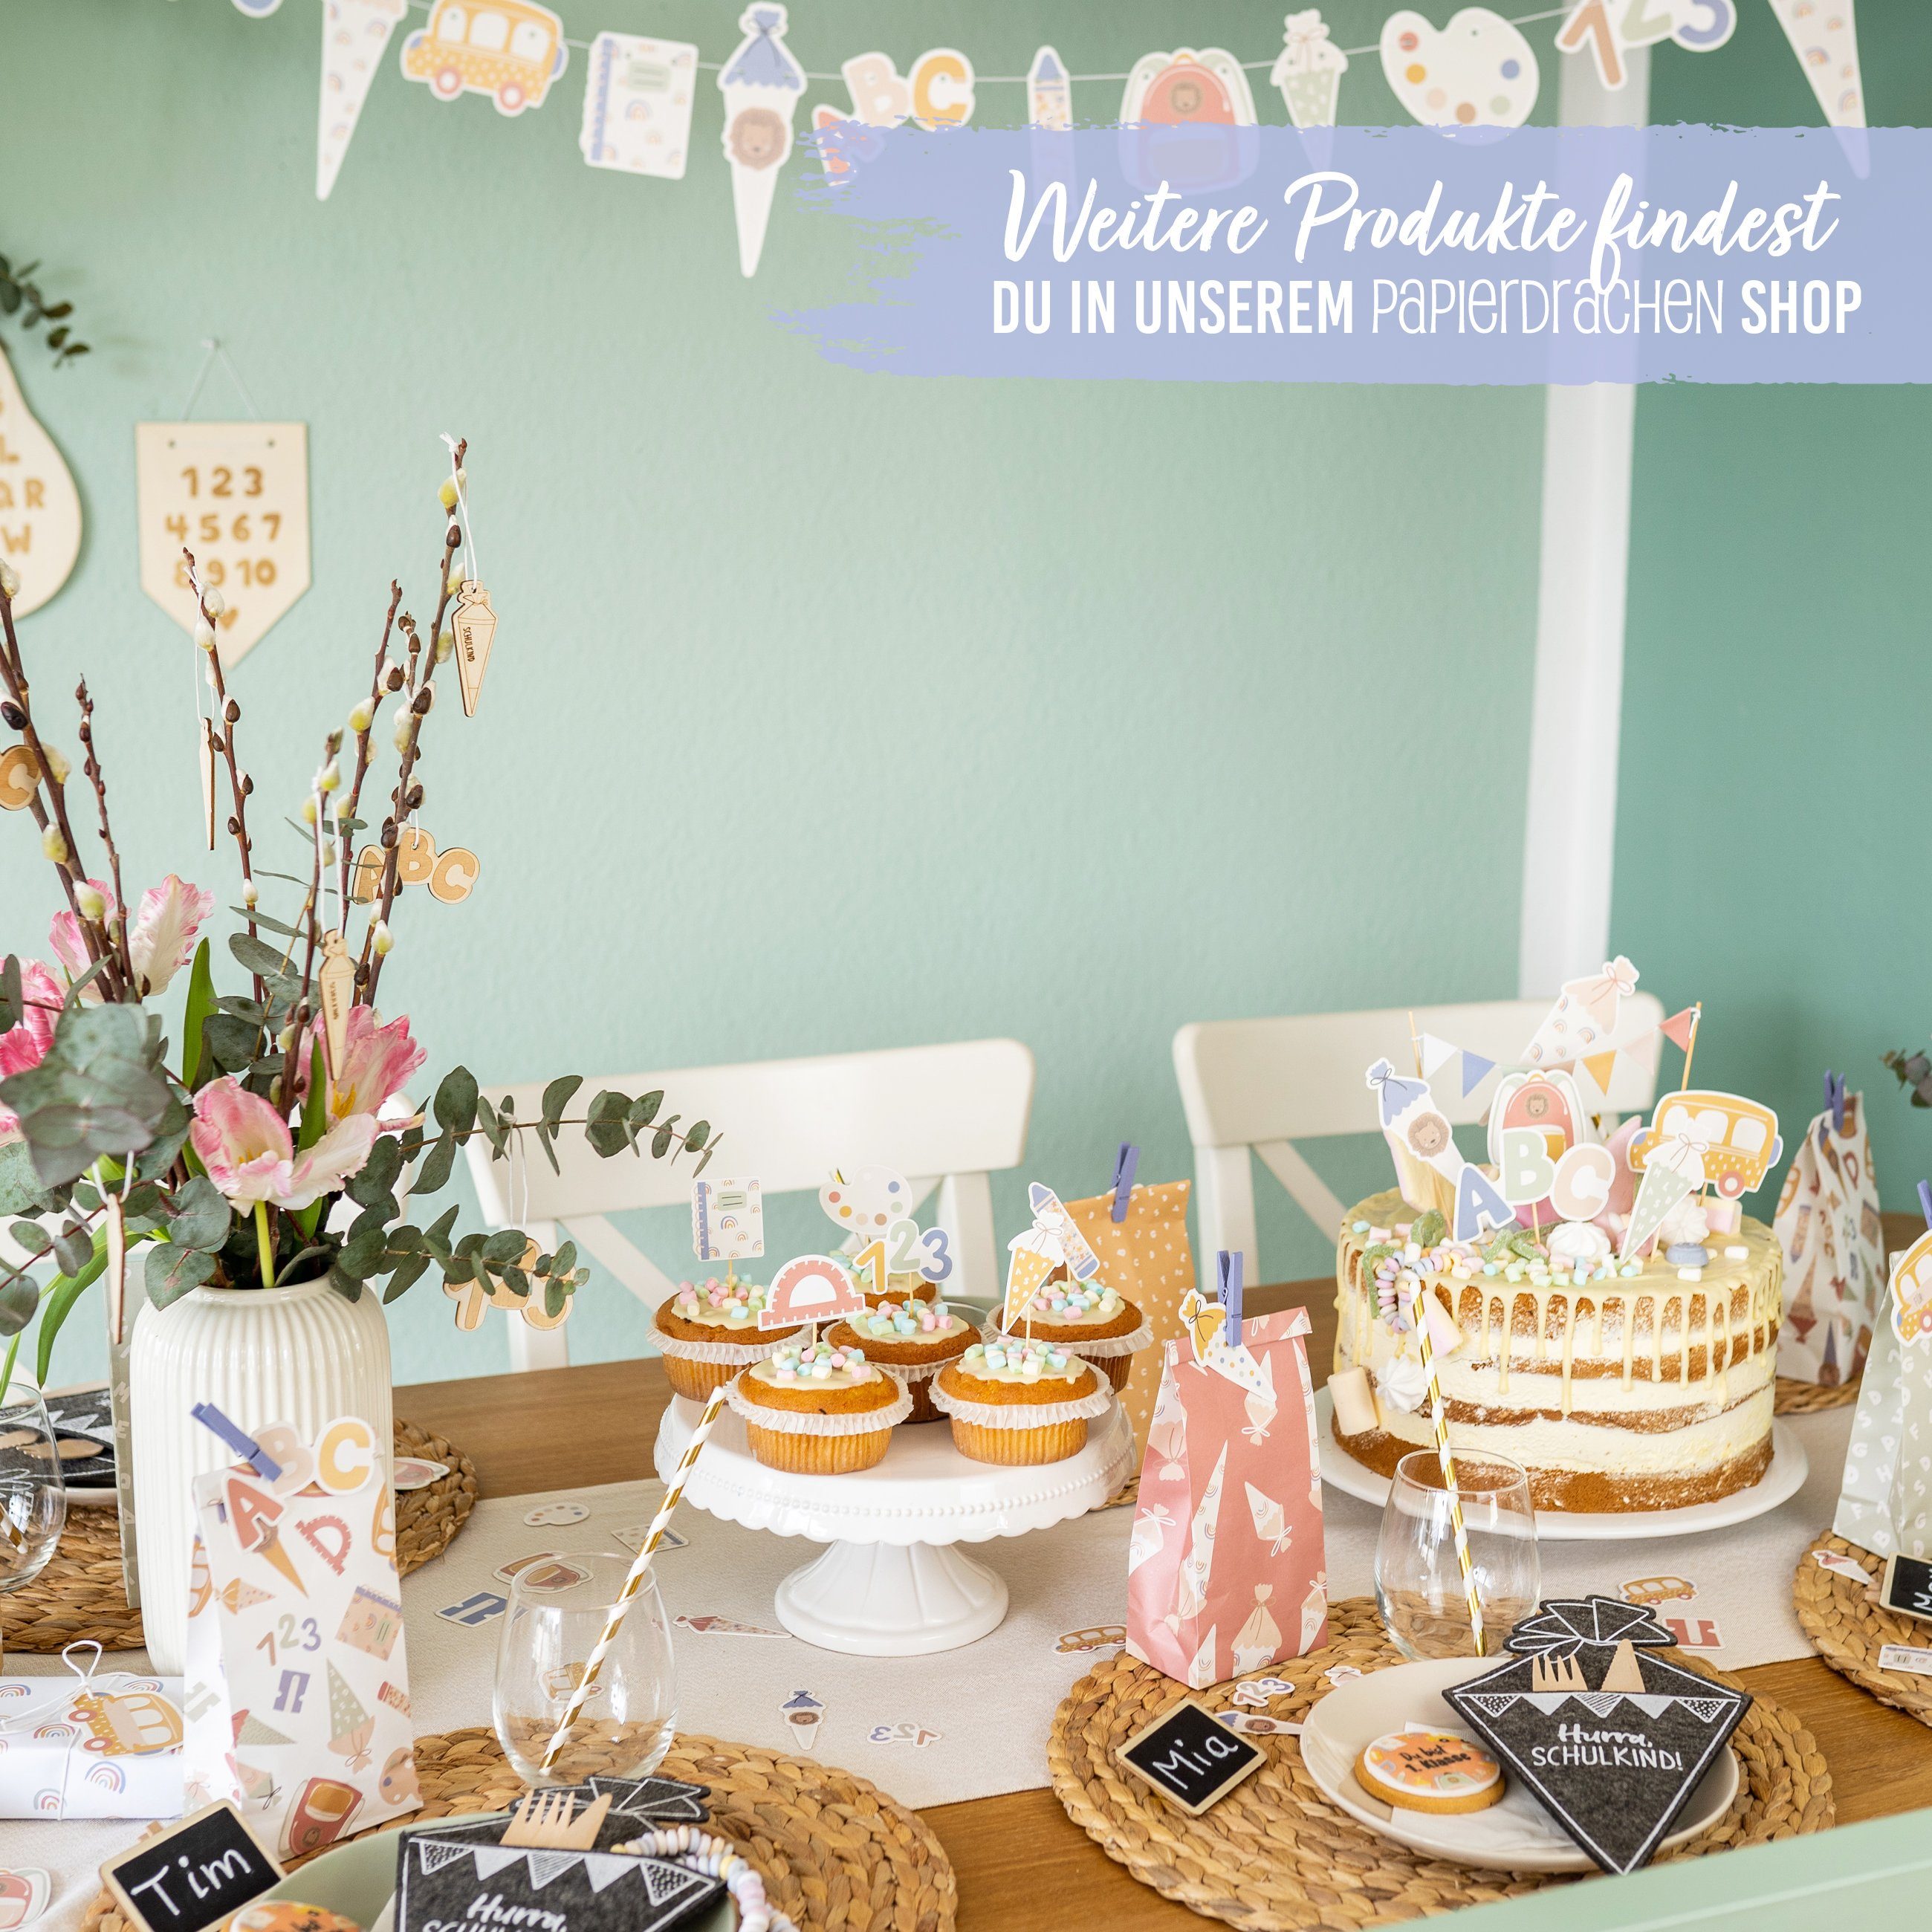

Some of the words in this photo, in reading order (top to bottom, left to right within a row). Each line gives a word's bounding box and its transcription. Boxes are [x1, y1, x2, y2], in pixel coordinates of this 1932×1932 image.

[463, 626, 476, 662] SCHULKIND
[357, 831, 476, 904] ABC
[1456, 1129, 1612, 1242] ABC
[855, 1219, 953, 1292] 123
[227, 1422, 372, 1550] ABC
[256, 1613, 322, 1667] 123
[1236, 1679, 1291, 1704] 123
[1399, 1751, 1423, 1762] Du
[1418, 1744, 1448, 1757] bist
[1419, 1752, 1472, 1770] Klasse
[1531, 1744, 1684, 1771] SCHULKIND!
[1557, 1722, 1653, 1748] Hurra,
[1152, 1736, 1239, 1790] Mia
[130, 1847, 253, 1917] Tim
